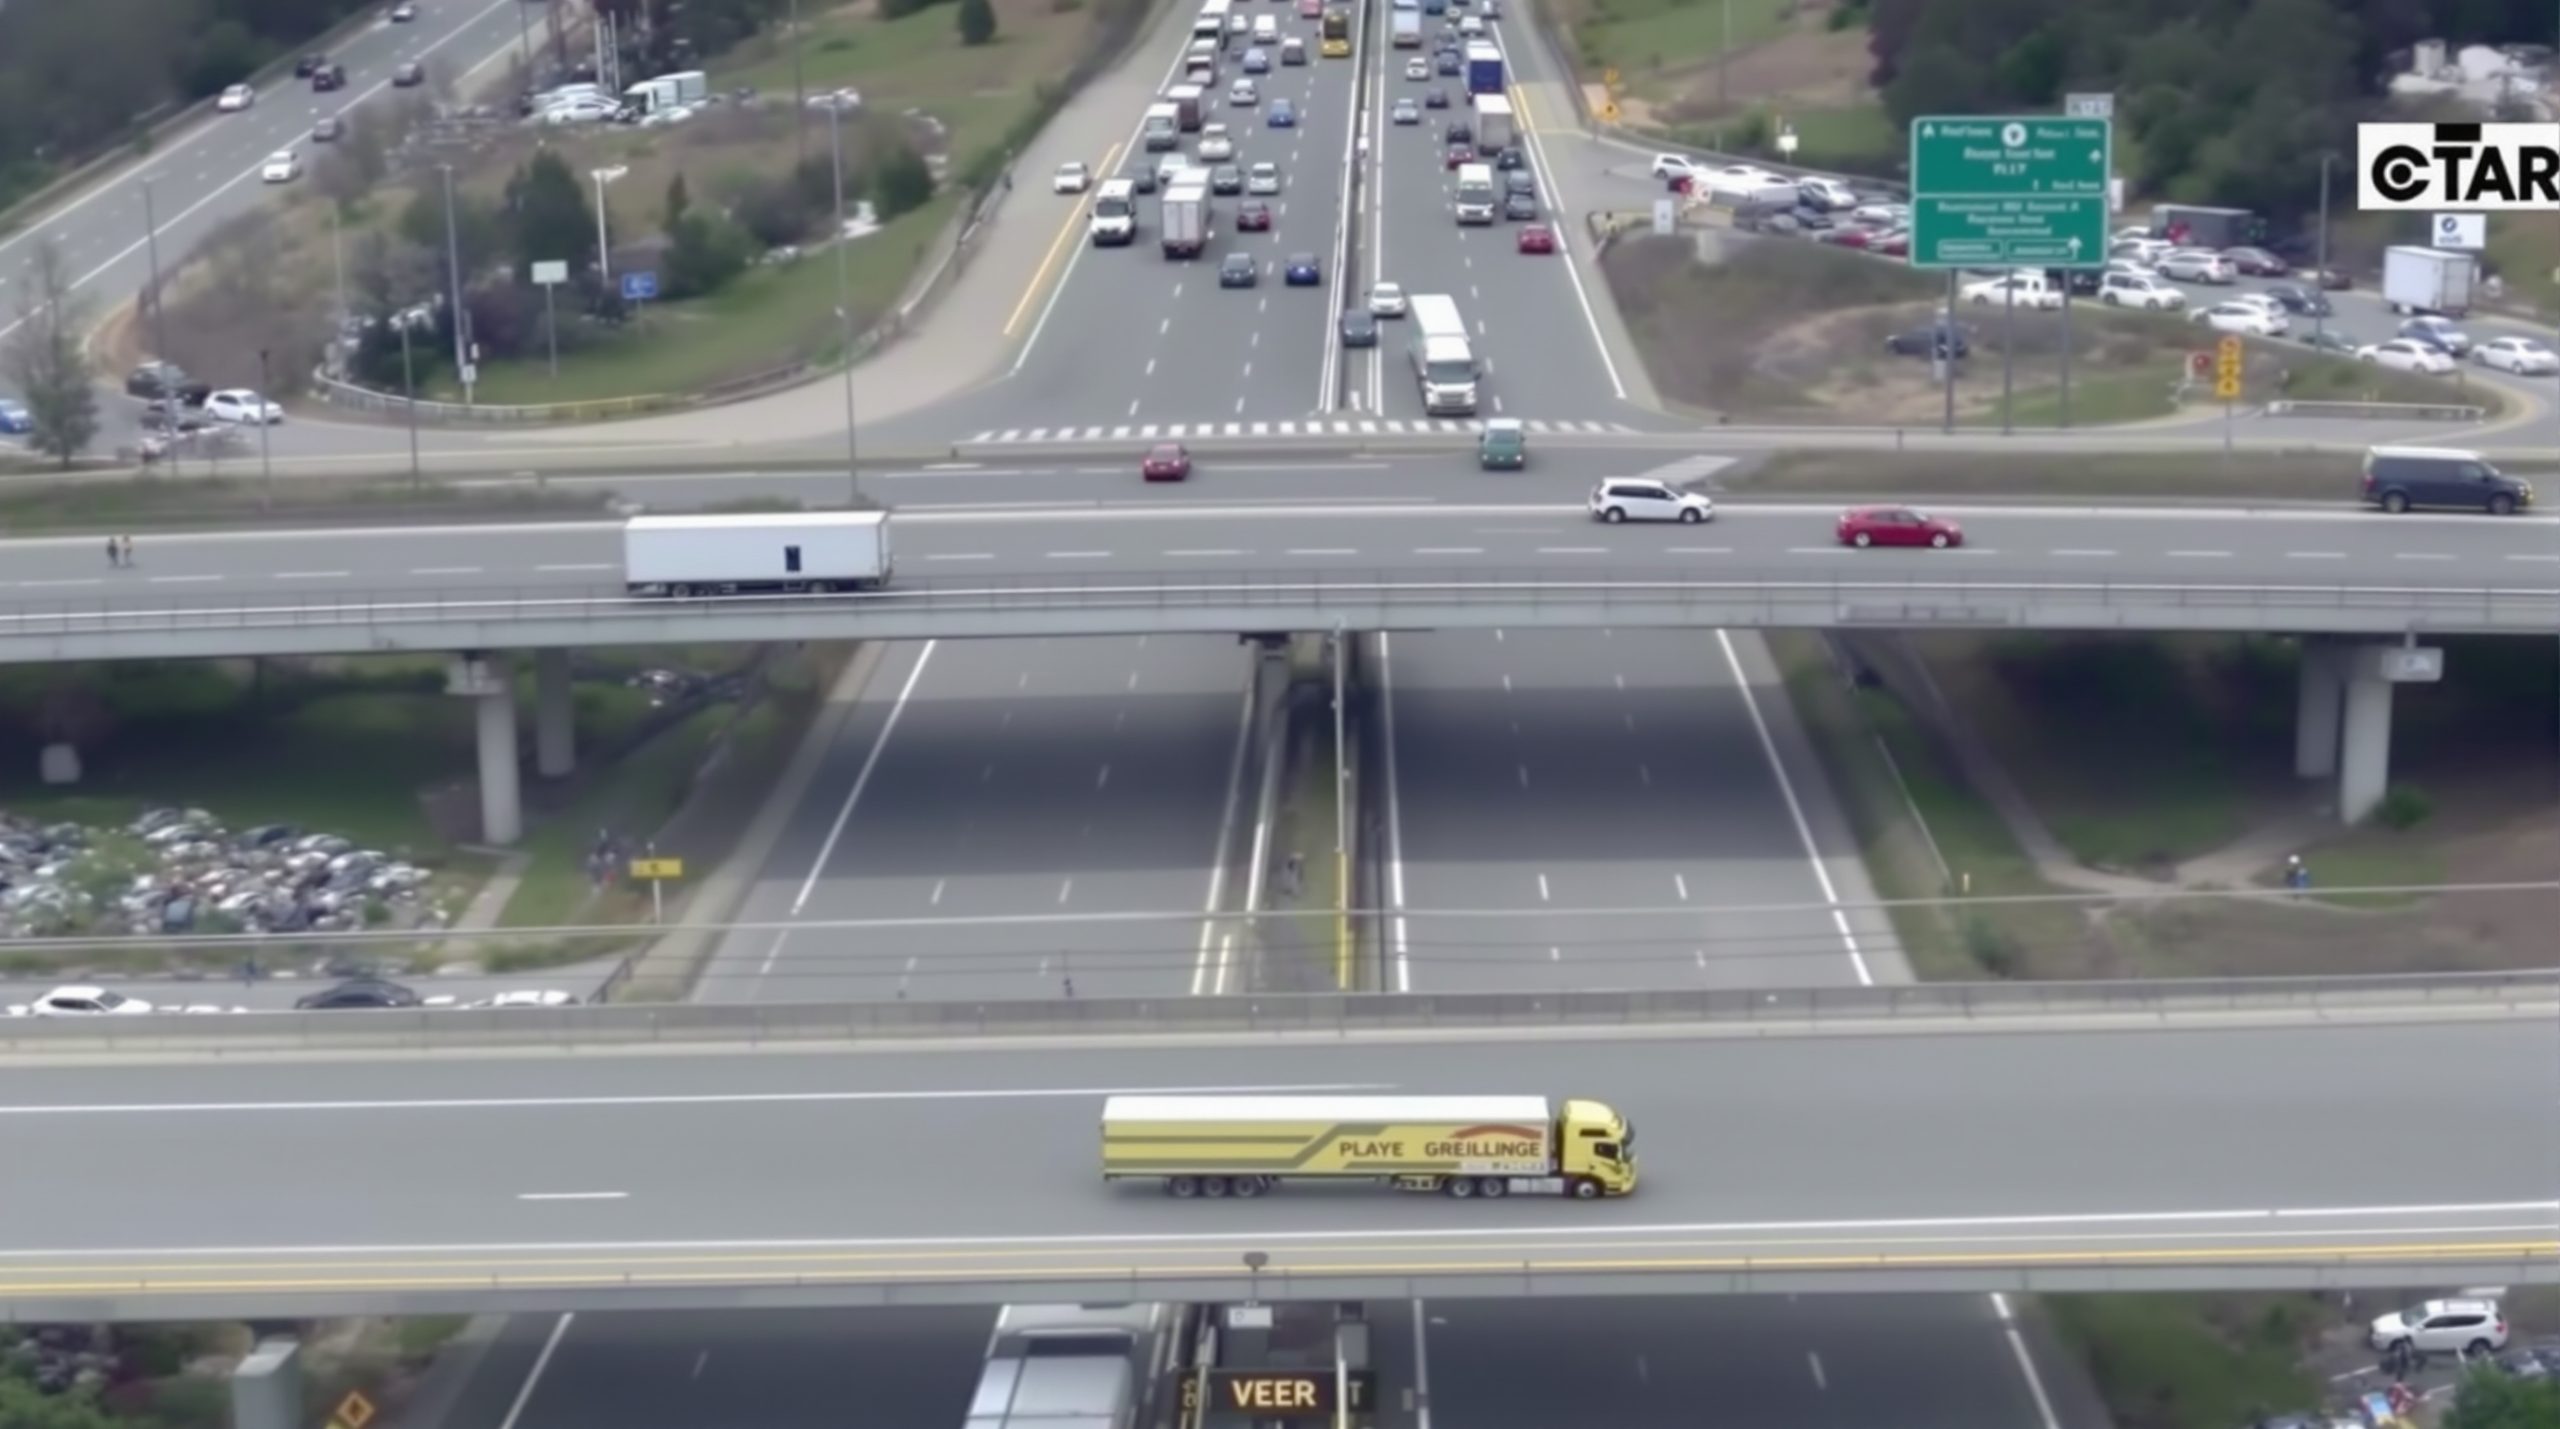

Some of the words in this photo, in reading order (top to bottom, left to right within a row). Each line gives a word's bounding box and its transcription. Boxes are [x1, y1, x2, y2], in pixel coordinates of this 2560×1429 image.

[1339, 1142, 1404, 1157] PLAYE
[1424, 1141, 1541, 1158] GREILLINGE
[1231, 1379, 1317, 1407] VEER
